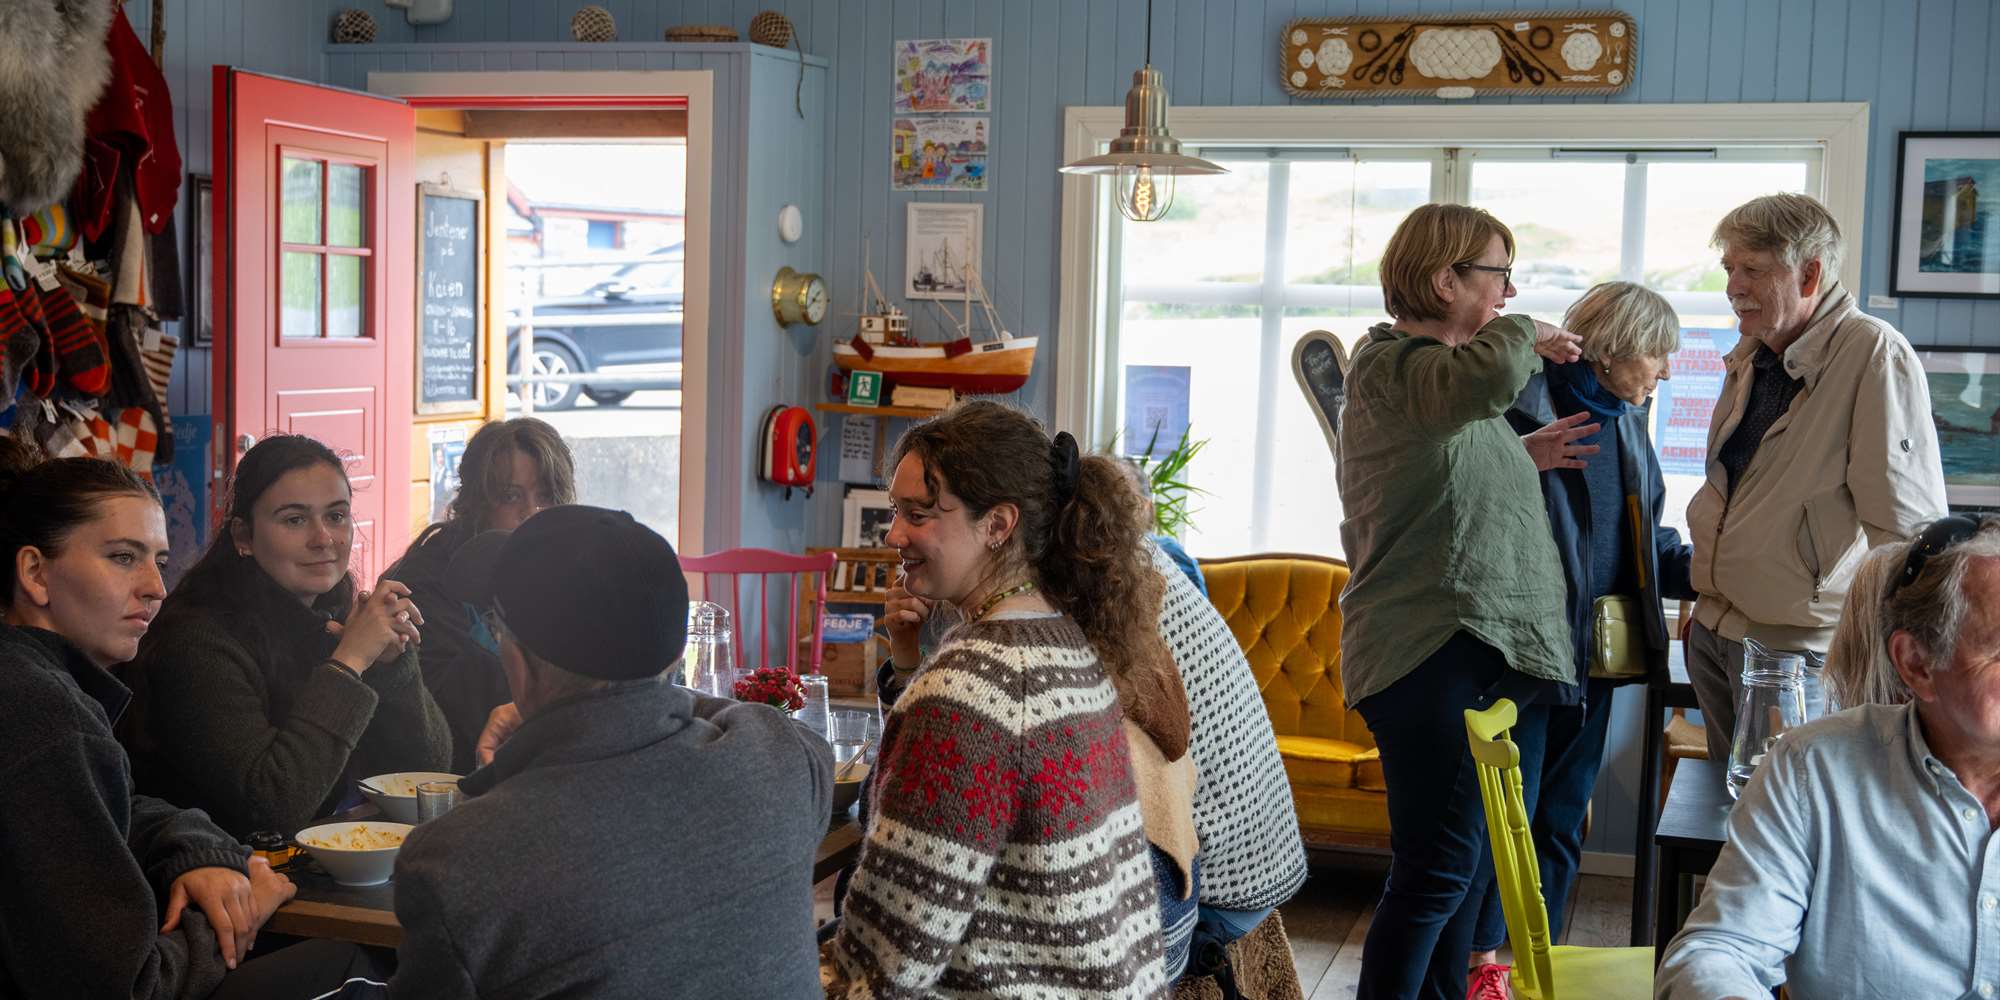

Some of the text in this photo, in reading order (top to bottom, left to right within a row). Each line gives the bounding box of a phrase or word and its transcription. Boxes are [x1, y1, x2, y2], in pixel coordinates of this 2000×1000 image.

[441, 241, 455, 267] på
[428, 270, 464, 298] Kaien
[823, 618, 863, 629] FEDJE
